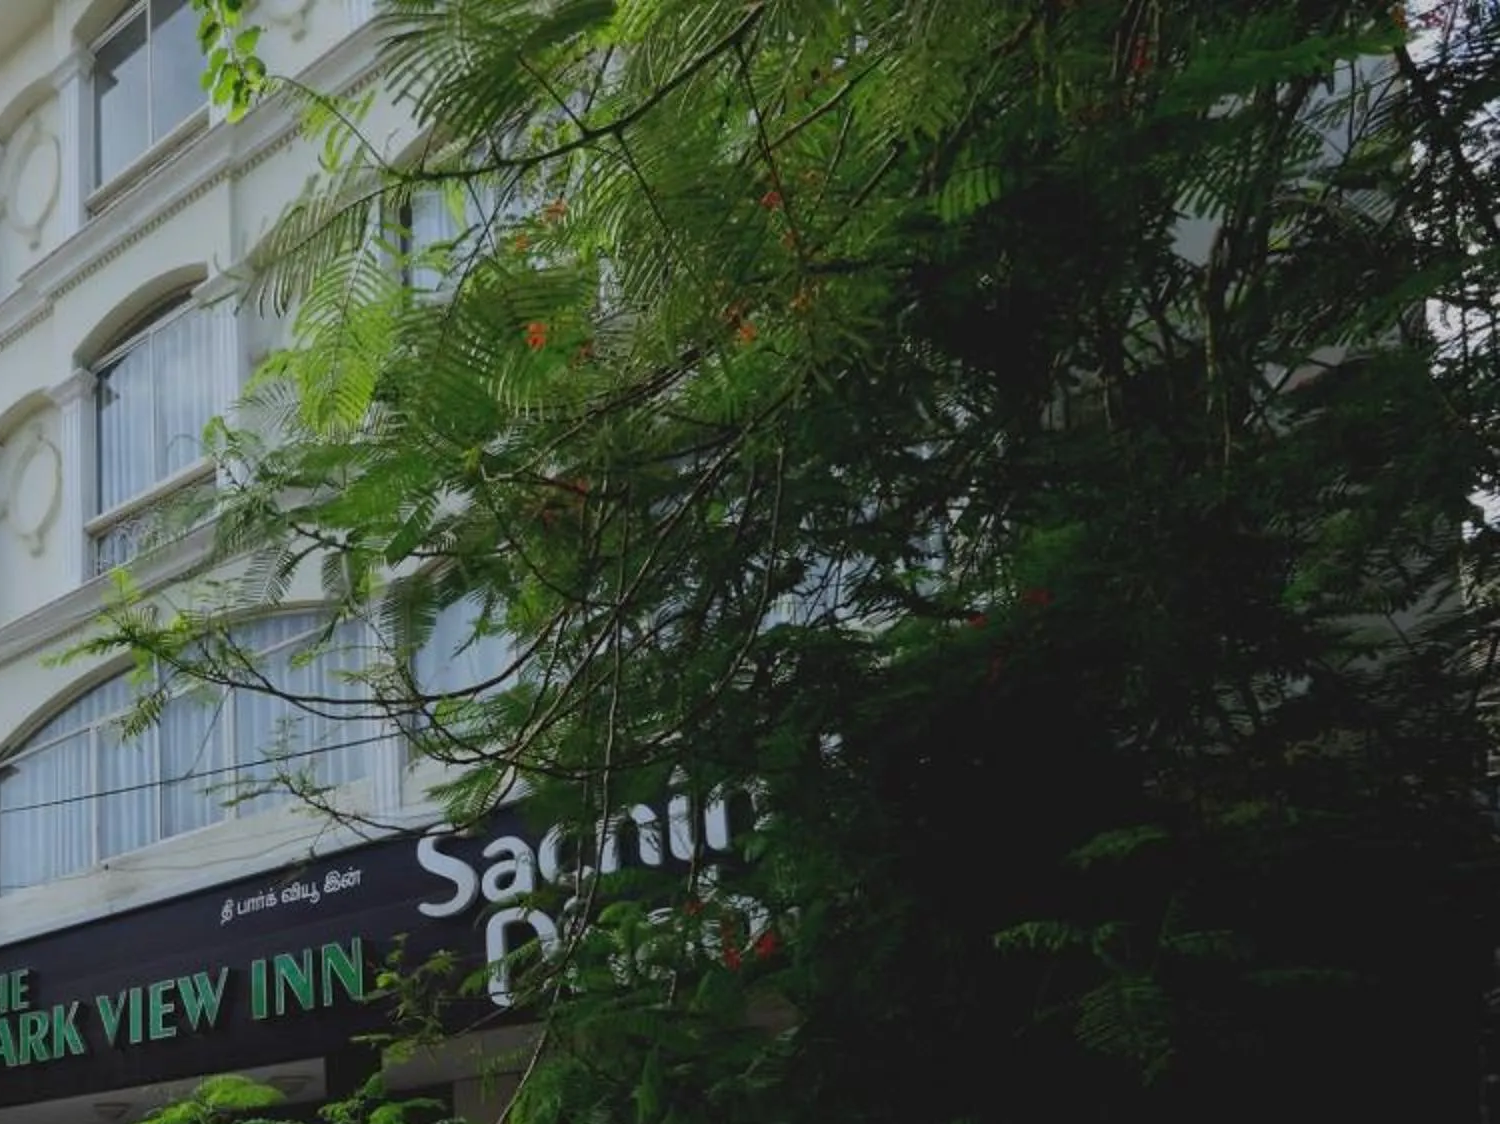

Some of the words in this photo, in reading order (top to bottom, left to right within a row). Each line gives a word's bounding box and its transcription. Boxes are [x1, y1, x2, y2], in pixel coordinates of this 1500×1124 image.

[324, 867, 362, 893] இன்
[96, 966, 229, 1047] VIEW
[251, 936, 364, 1020] INN
